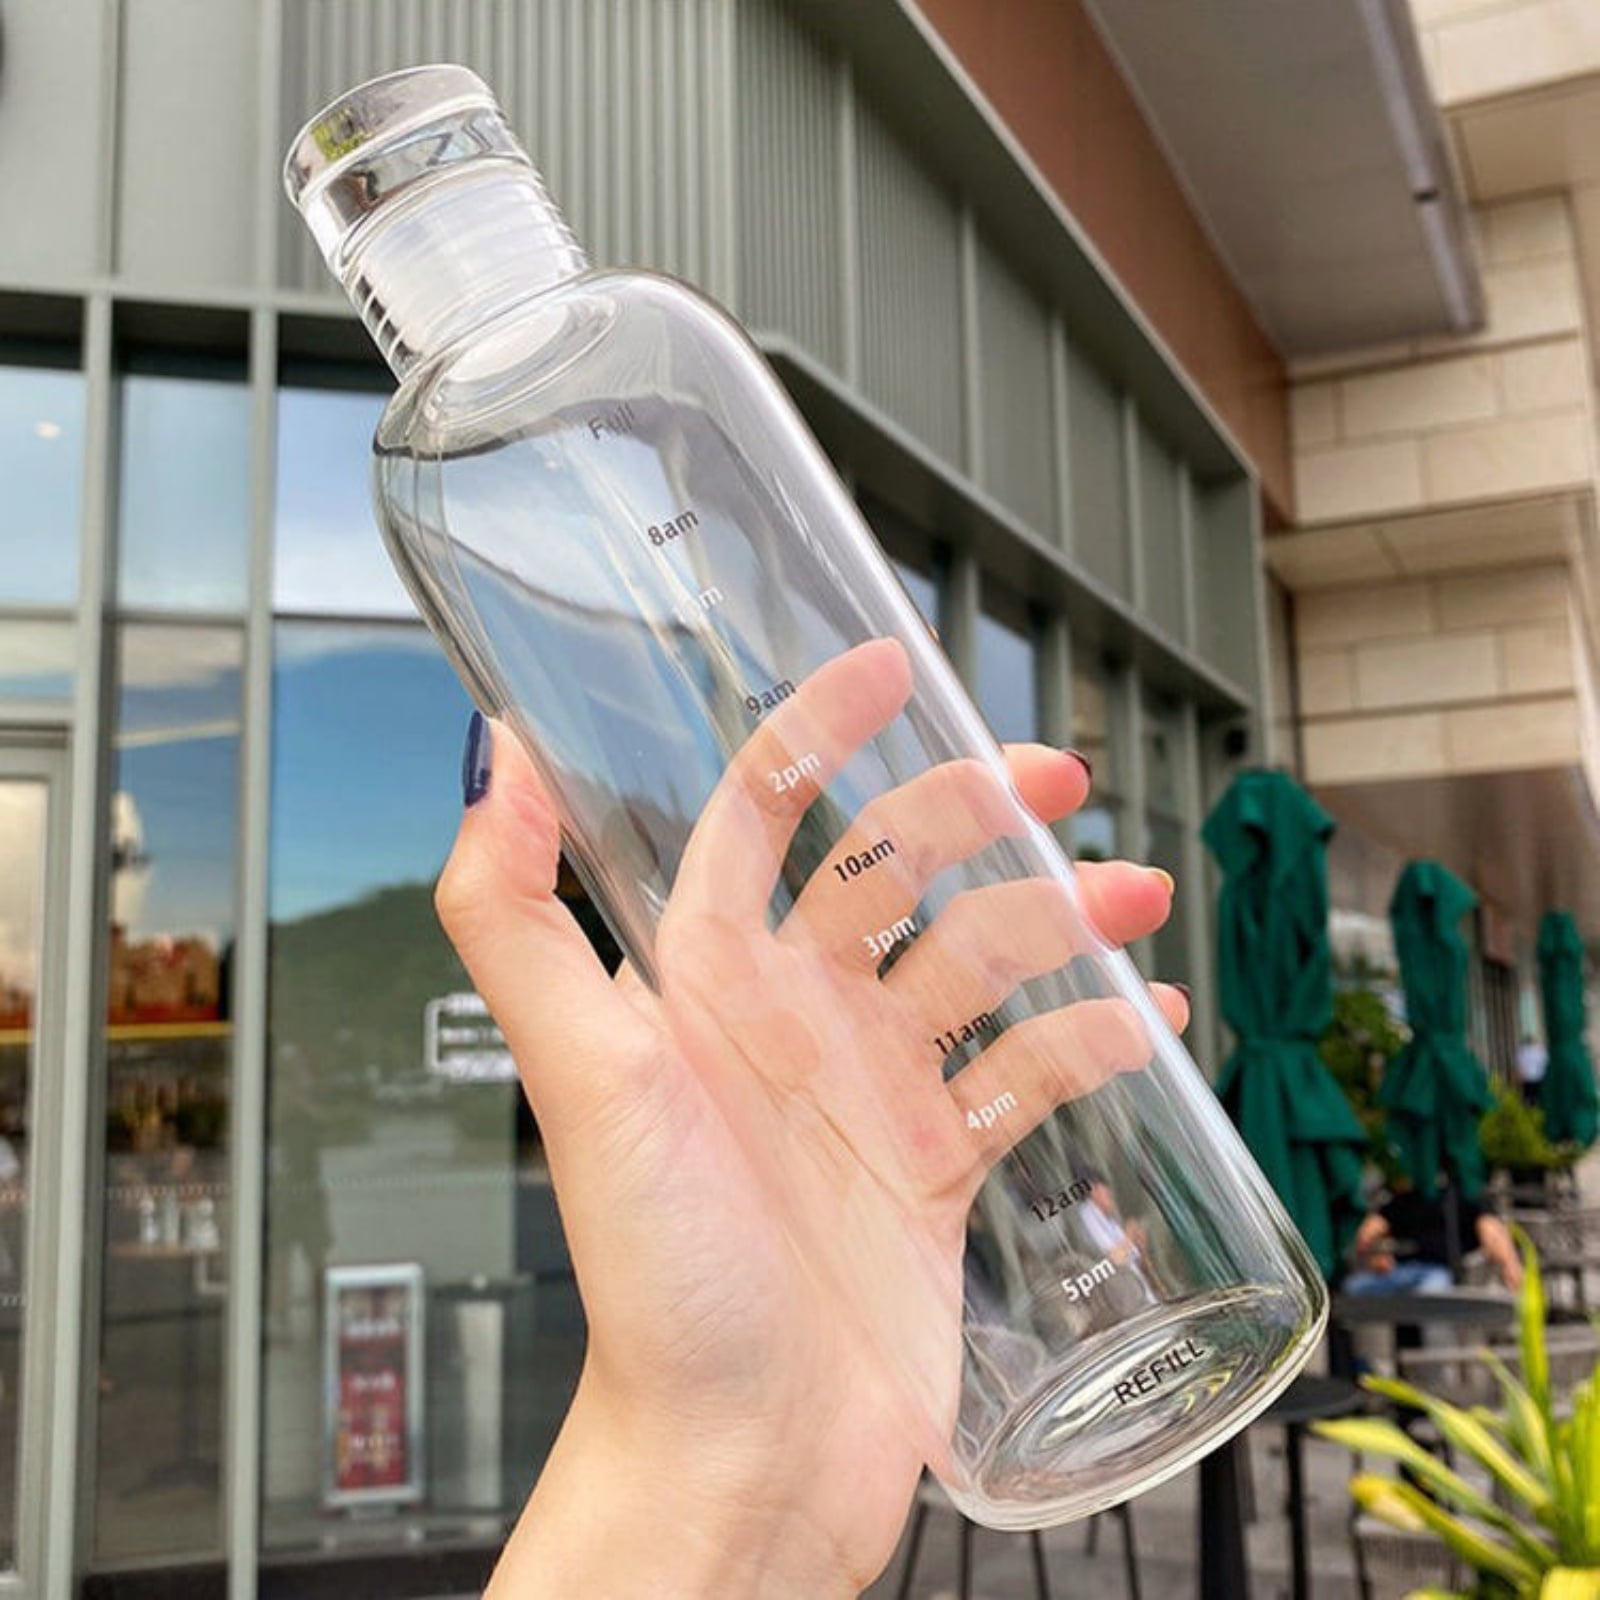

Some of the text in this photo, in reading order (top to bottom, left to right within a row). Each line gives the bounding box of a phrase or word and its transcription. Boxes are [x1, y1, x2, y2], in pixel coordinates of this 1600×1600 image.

[587, 402, 635, 440] Full
[648, 509, 699, 547] 8am
[745, 679, 796, 716] 9am
[767, 751, 821, 793] 2pm
[833, 838, 896, 882] 10am
[862, 914, 917, 957] 3pm
[933, 1011, 998, 1056] 11am
[966, 1090, 1019, 1130] 4pm
[1030, 1178, 1093, 1222] 12am
[1060, 1257, 1117, 1302] 5pm
[1112, 1338, 1205, 1405] REFILL
